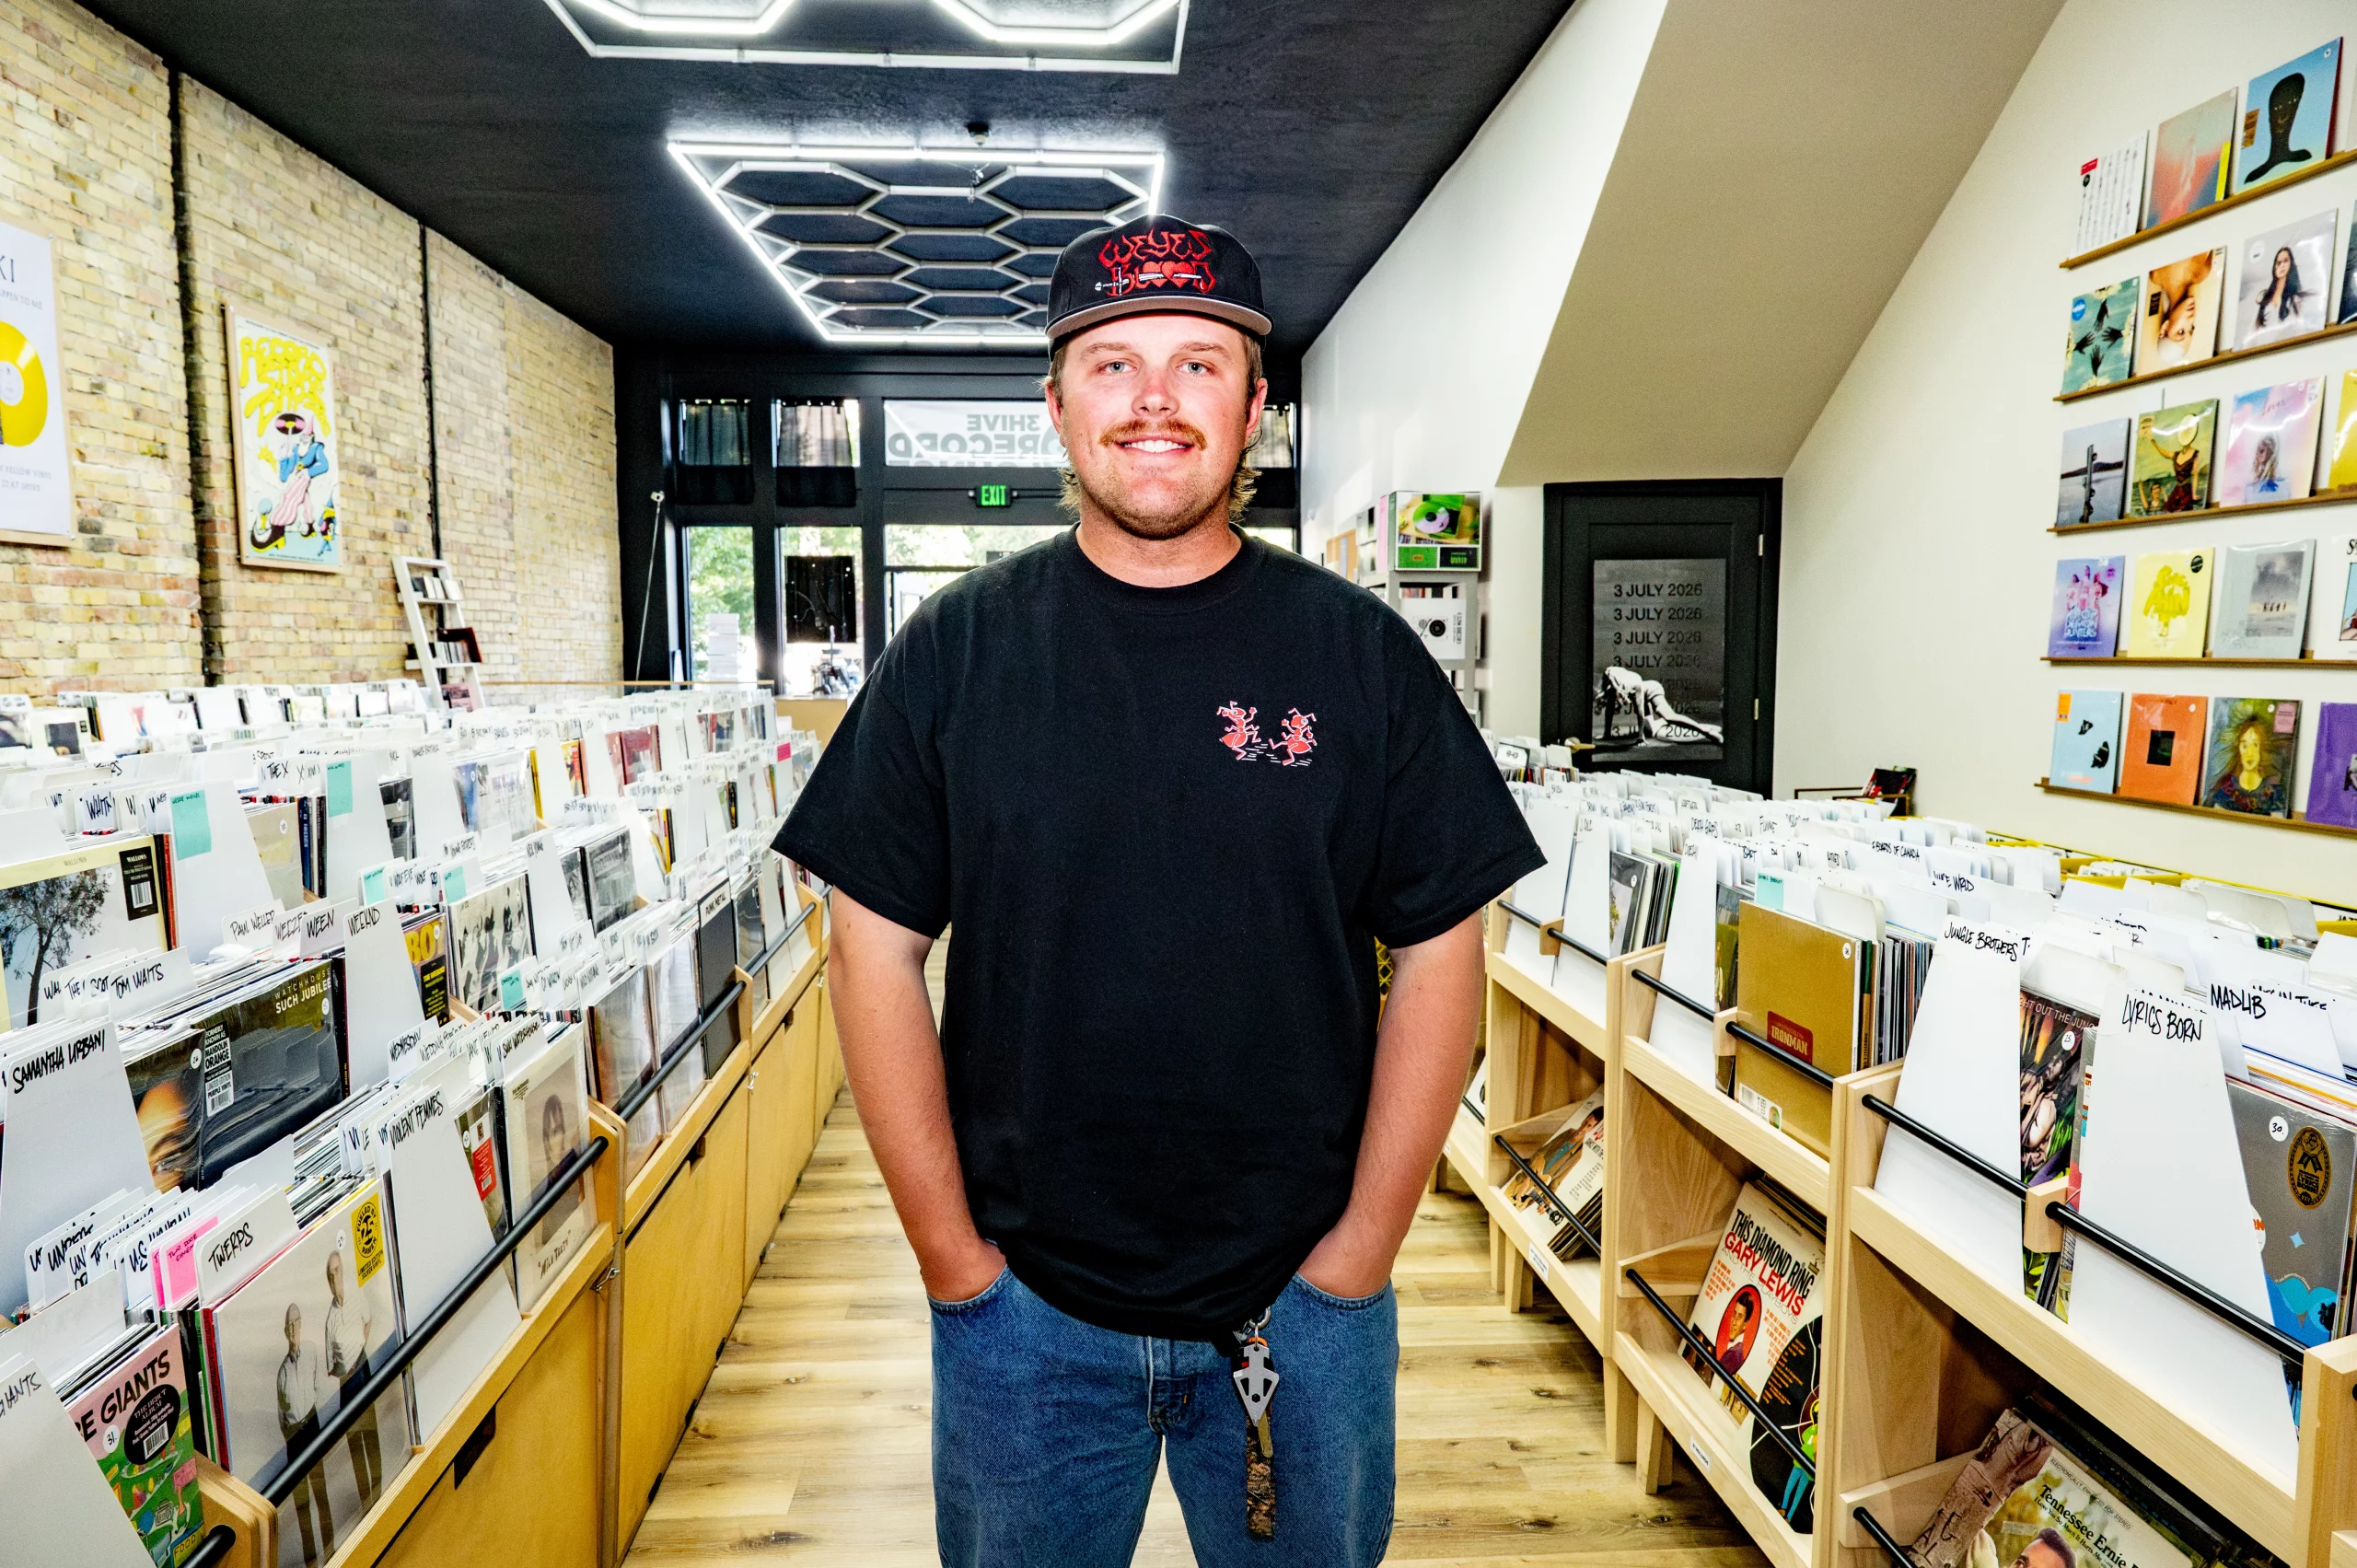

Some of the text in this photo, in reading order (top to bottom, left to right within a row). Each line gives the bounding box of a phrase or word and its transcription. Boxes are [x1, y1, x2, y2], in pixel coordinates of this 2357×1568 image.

[1098, 227, 1213, 268] WEYES
[239, 337, 327, 388] RECORD
[981, 485, 1006, 505] EXIT
[1614, 584, 1622, 597] 3
[1626, 584, 1664, 597] JULY
[1614, 608, 1622, 621] 3
[1626, 608, 1664, 621] JULY
[1614, 632, 1622, 644] 3
[1626, 632, 1664, 644] JULY
[1690, 818, 1703, 831] DEATH
[1893, 845, 1899, 855] OF
[1900, 846, 1920, 862] CANADA
[1953, 874, 1975, 893] WRLD
[230, 922, 250, 941] PAUL
[275, 912, 308, 942] WEEZE
[307, 909, 334, 939] WEEN
[348, 906, 380, 937] WEEKND
[1945, 922, 2018, 962] JUNGLE BROTHERS
[110, 963, 164, 1000] TOM WAITS
[274, 969, 331, 1000] WATCHHOUSE
[276, 978, 331, 1014] SUCH JUBILEE
[2035, 1003, 2051, 1017] OUT
[2054, 1010, 2071, 1025] THE
[2211, 983, 2267, 1019] MADLIB
[2121, 994, 2202, 1042] LYRICS BORN
[205, 1030, 226, 1045] KNOWN AS
[205, 1040, 228, 1058] MANDOLIN
[389, 1027, 422, 1063] WEDNESDAY
[1771, 1025, 1808, 1056] IRONMAN
[13, 1028, 105, 1095] SAMANTHA URBANI
[205, 1049, 229, 1069] ORANGE
[389, 1090, 444, 1151] VIOLENT FEMMES
[356, 1205, 370, 1232] FUELED
[168, 1233, 197, 1260] TWO DOOR
[208, 1222, 253, 1272] TWERPS
[358, 1249, 383, 1277] LIMITED EDITION
[1724, 1231, 1762, 1272] GARY
[1759, 1262, 1805, 1316] LEWIS
[1722, 1247, 1738, 1266] AND
[1740, 1261, 1757, 1283] THE
[1757, 1282, 1799, 1325] PLAYBOYS
[100, 1349, 170, 1424] GIANTS
[2037, 1499, 2049, 1512] Love
[2049, 1458, 2083, 1488] ELECTRONICALLY
[2104, 1504, 2115, 1516] FOR
[2114, 1513, 2131, 1530] STEREO
[2038, 1483, 2127, 1568] Tennessee Ernie
[174, 1534, 196, 1559] FOOD
